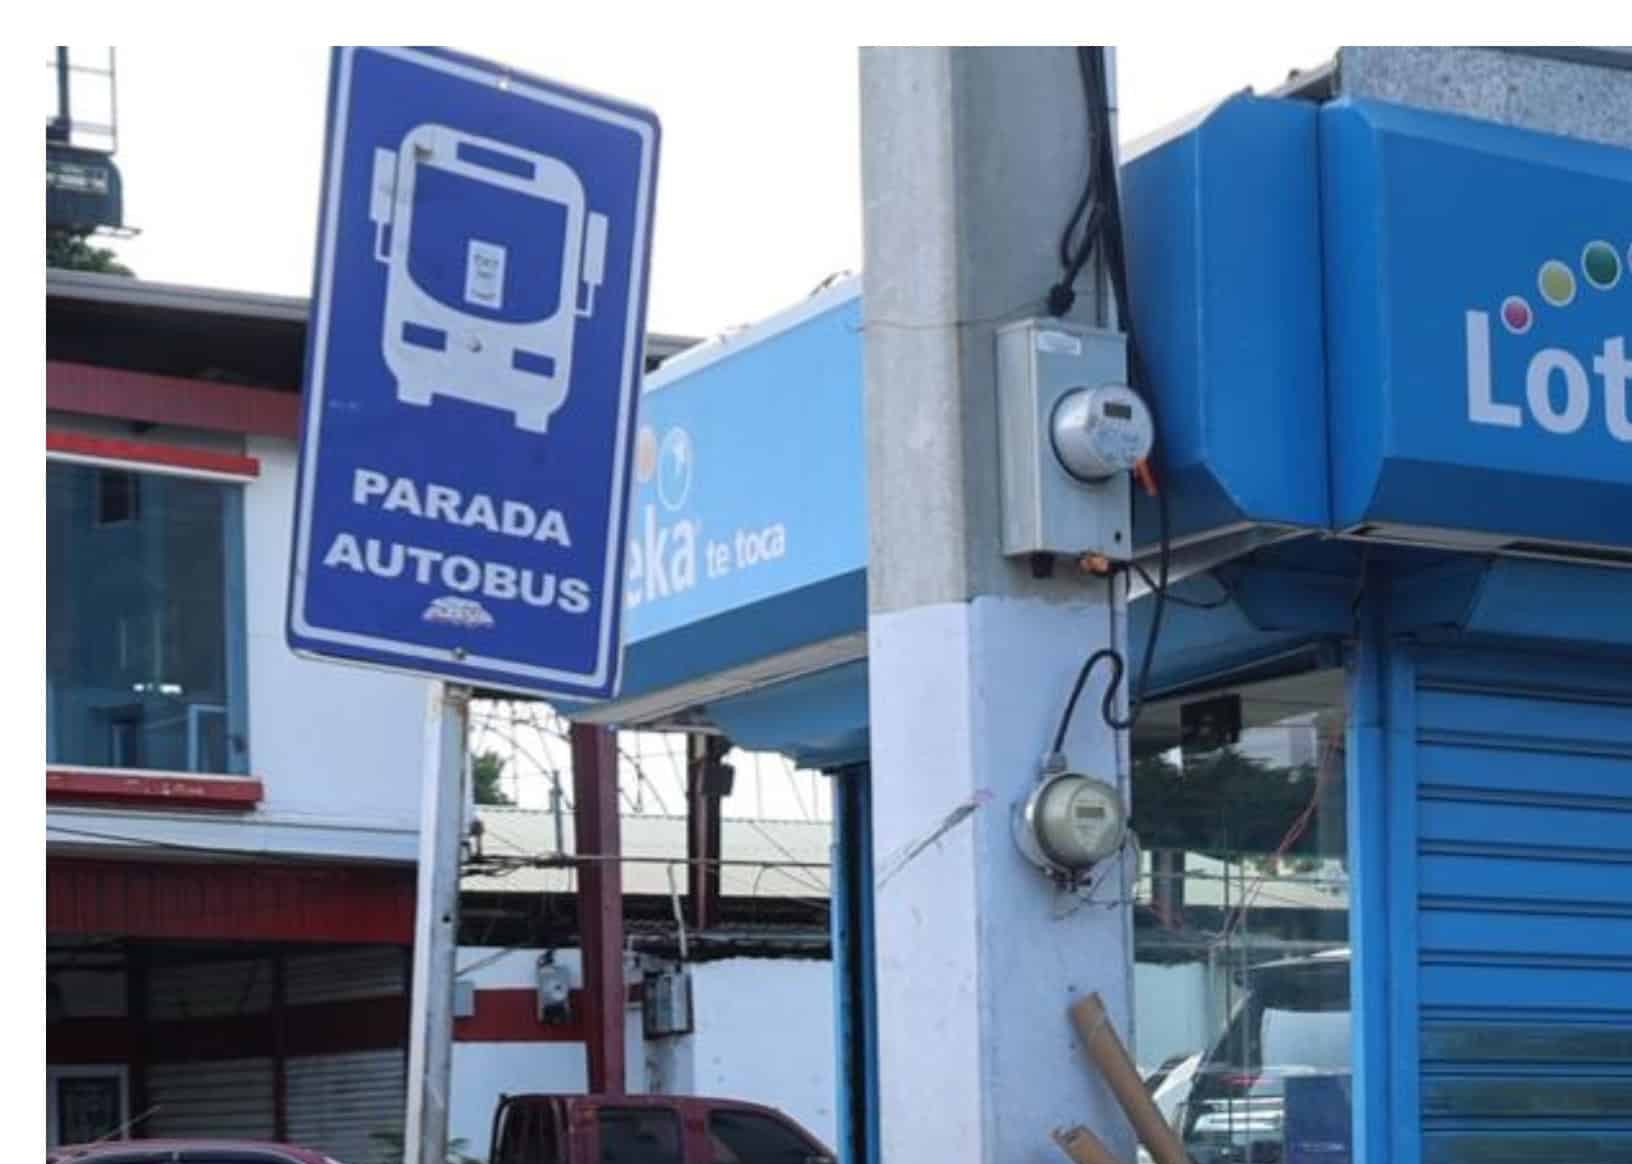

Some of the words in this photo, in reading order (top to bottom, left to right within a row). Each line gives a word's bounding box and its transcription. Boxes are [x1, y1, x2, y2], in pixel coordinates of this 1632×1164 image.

[354, 468, 571, 547] PARADA
[323, 533, 591, 614] AUTOBUS
[706, 539, 730, 578] te
[735, 522, 786, 568] toca
